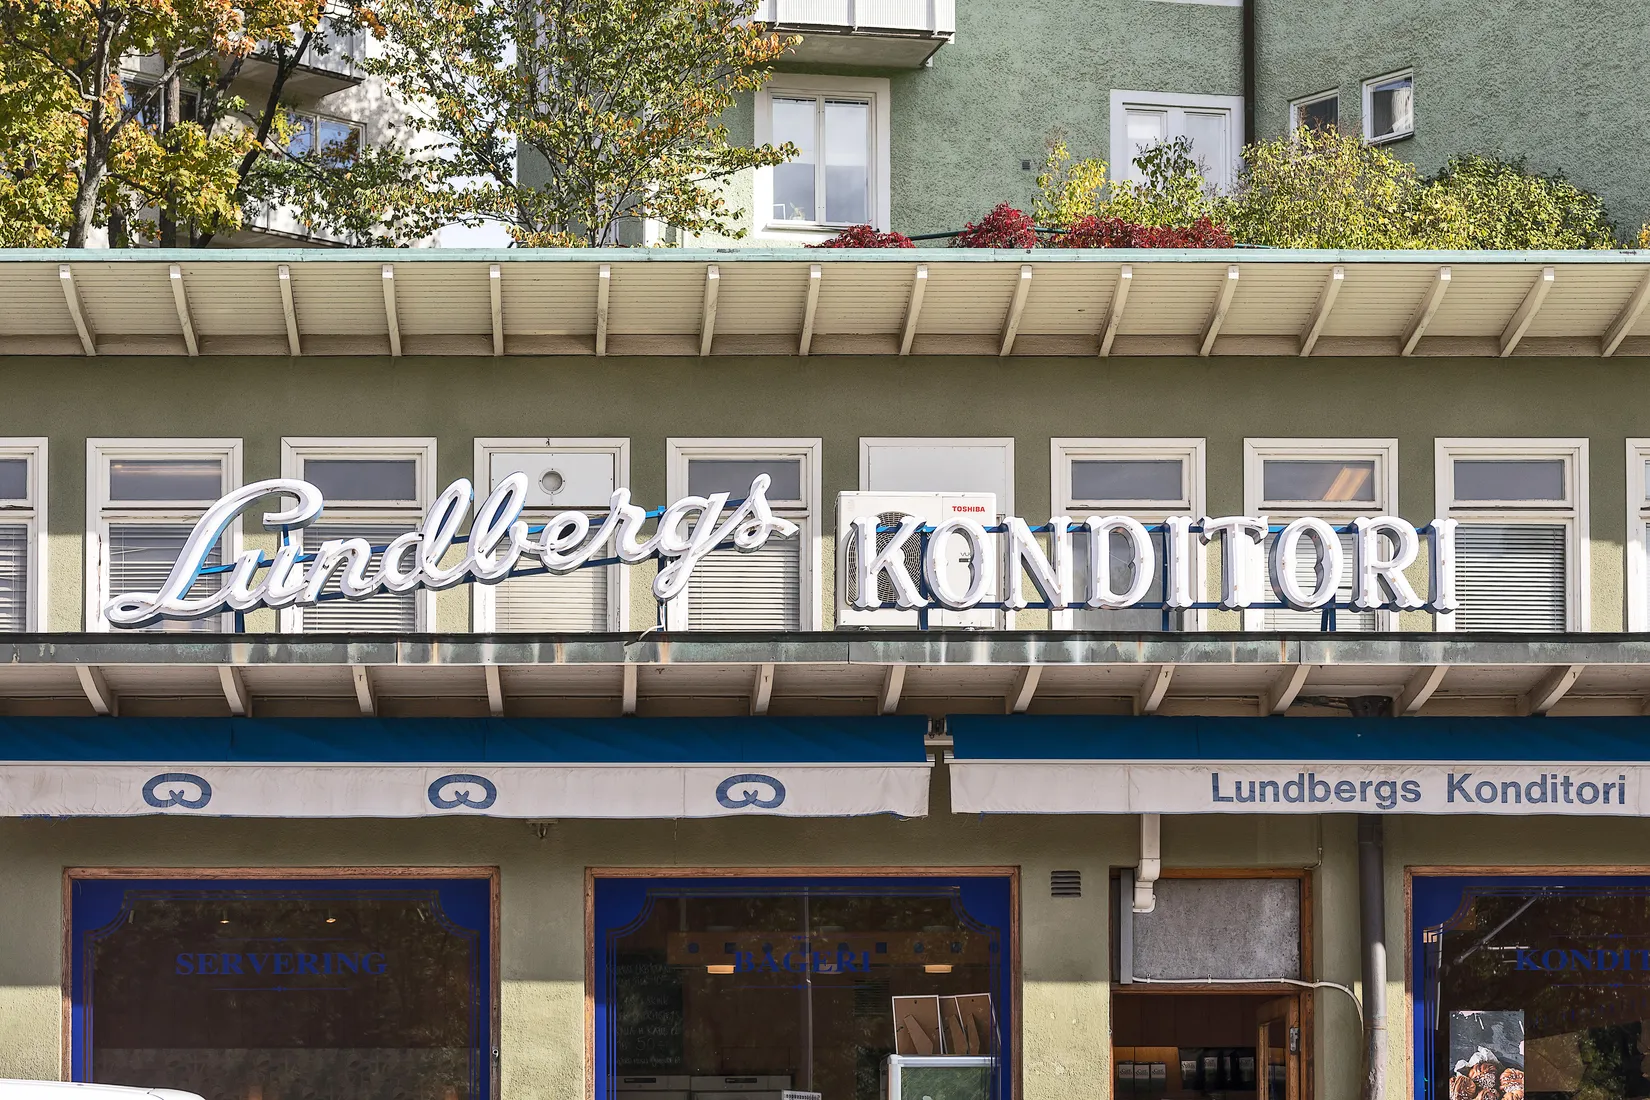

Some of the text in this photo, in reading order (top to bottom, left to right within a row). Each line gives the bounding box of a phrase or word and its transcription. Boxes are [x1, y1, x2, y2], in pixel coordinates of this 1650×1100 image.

[104, 472, 1460, 628] Lundbergs KONDITORI
[1211, 772, 1626, 810] Lundbergs Konditori
[175, 951, 388, 976] SERVERING
[734, 951, 872, 973] BAGERI
